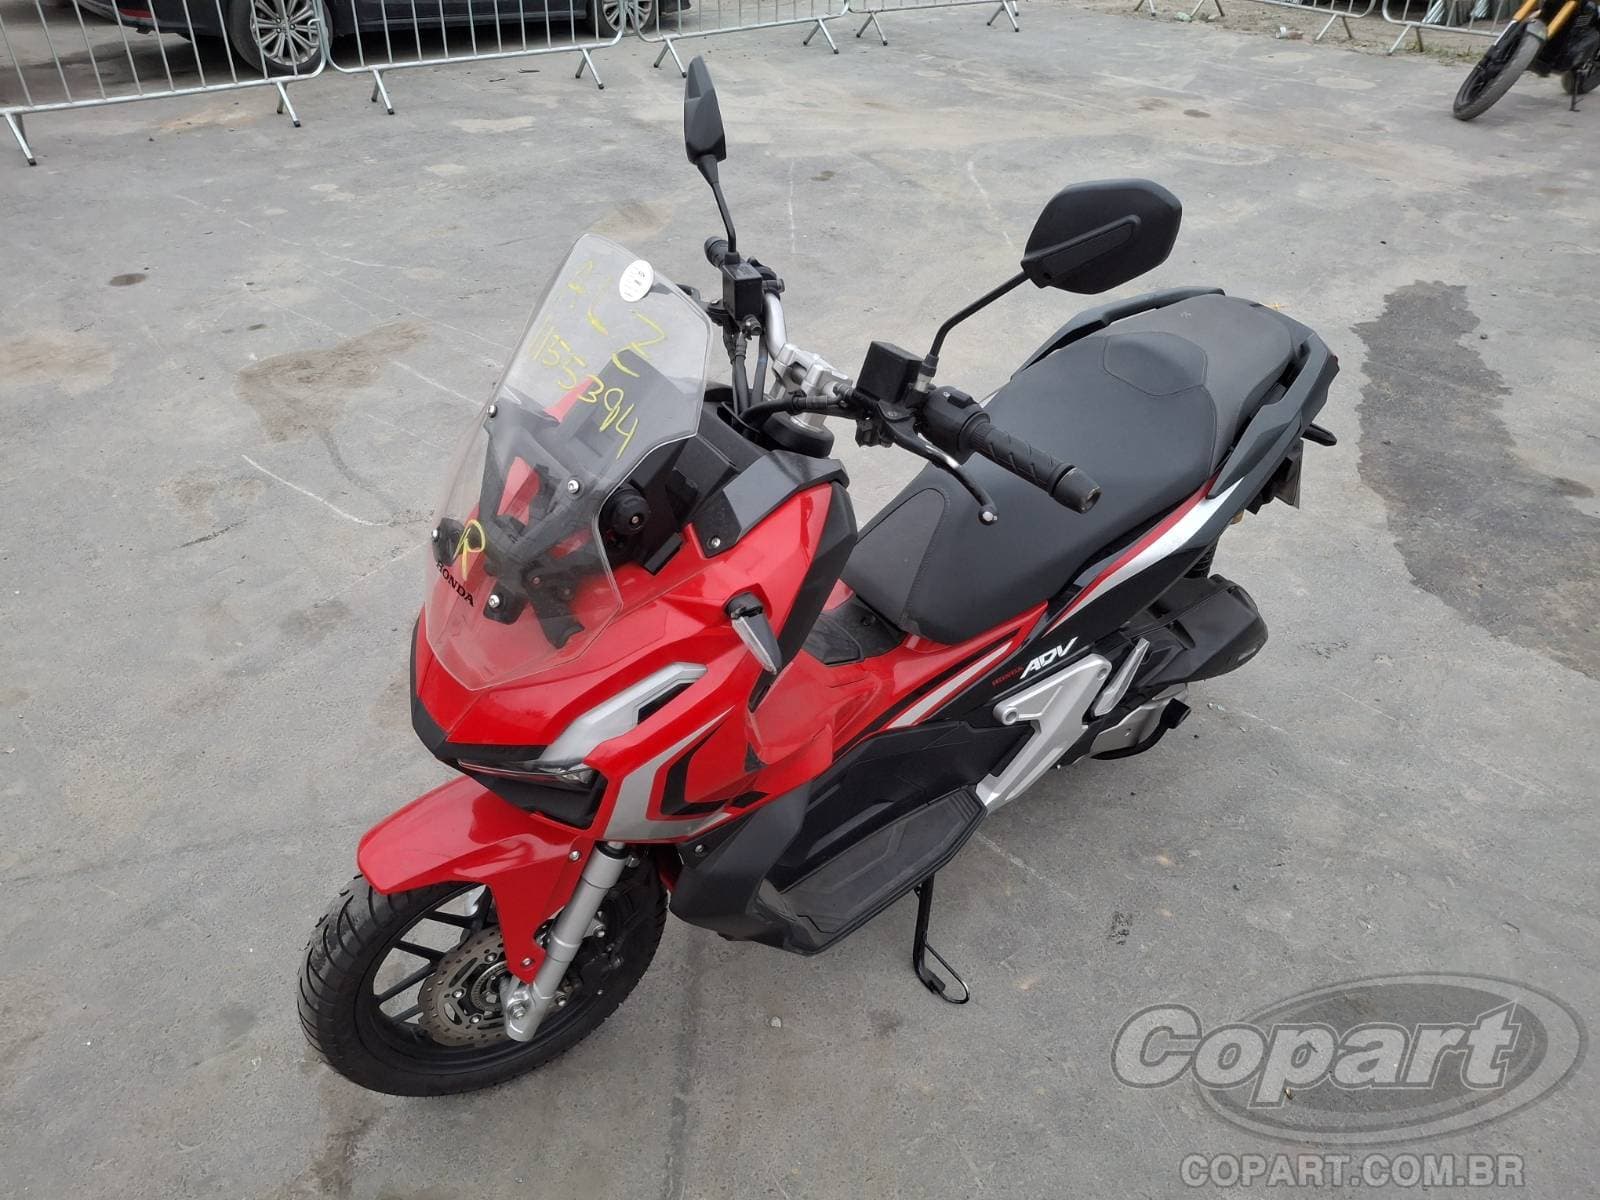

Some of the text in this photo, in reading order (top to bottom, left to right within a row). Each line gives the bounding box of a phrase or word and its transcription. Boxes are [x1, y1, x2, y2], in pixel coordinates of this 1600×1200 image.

[435, 560, 474, 608] HONDA
[991, 636, 1079, 687] HONDA ADV
